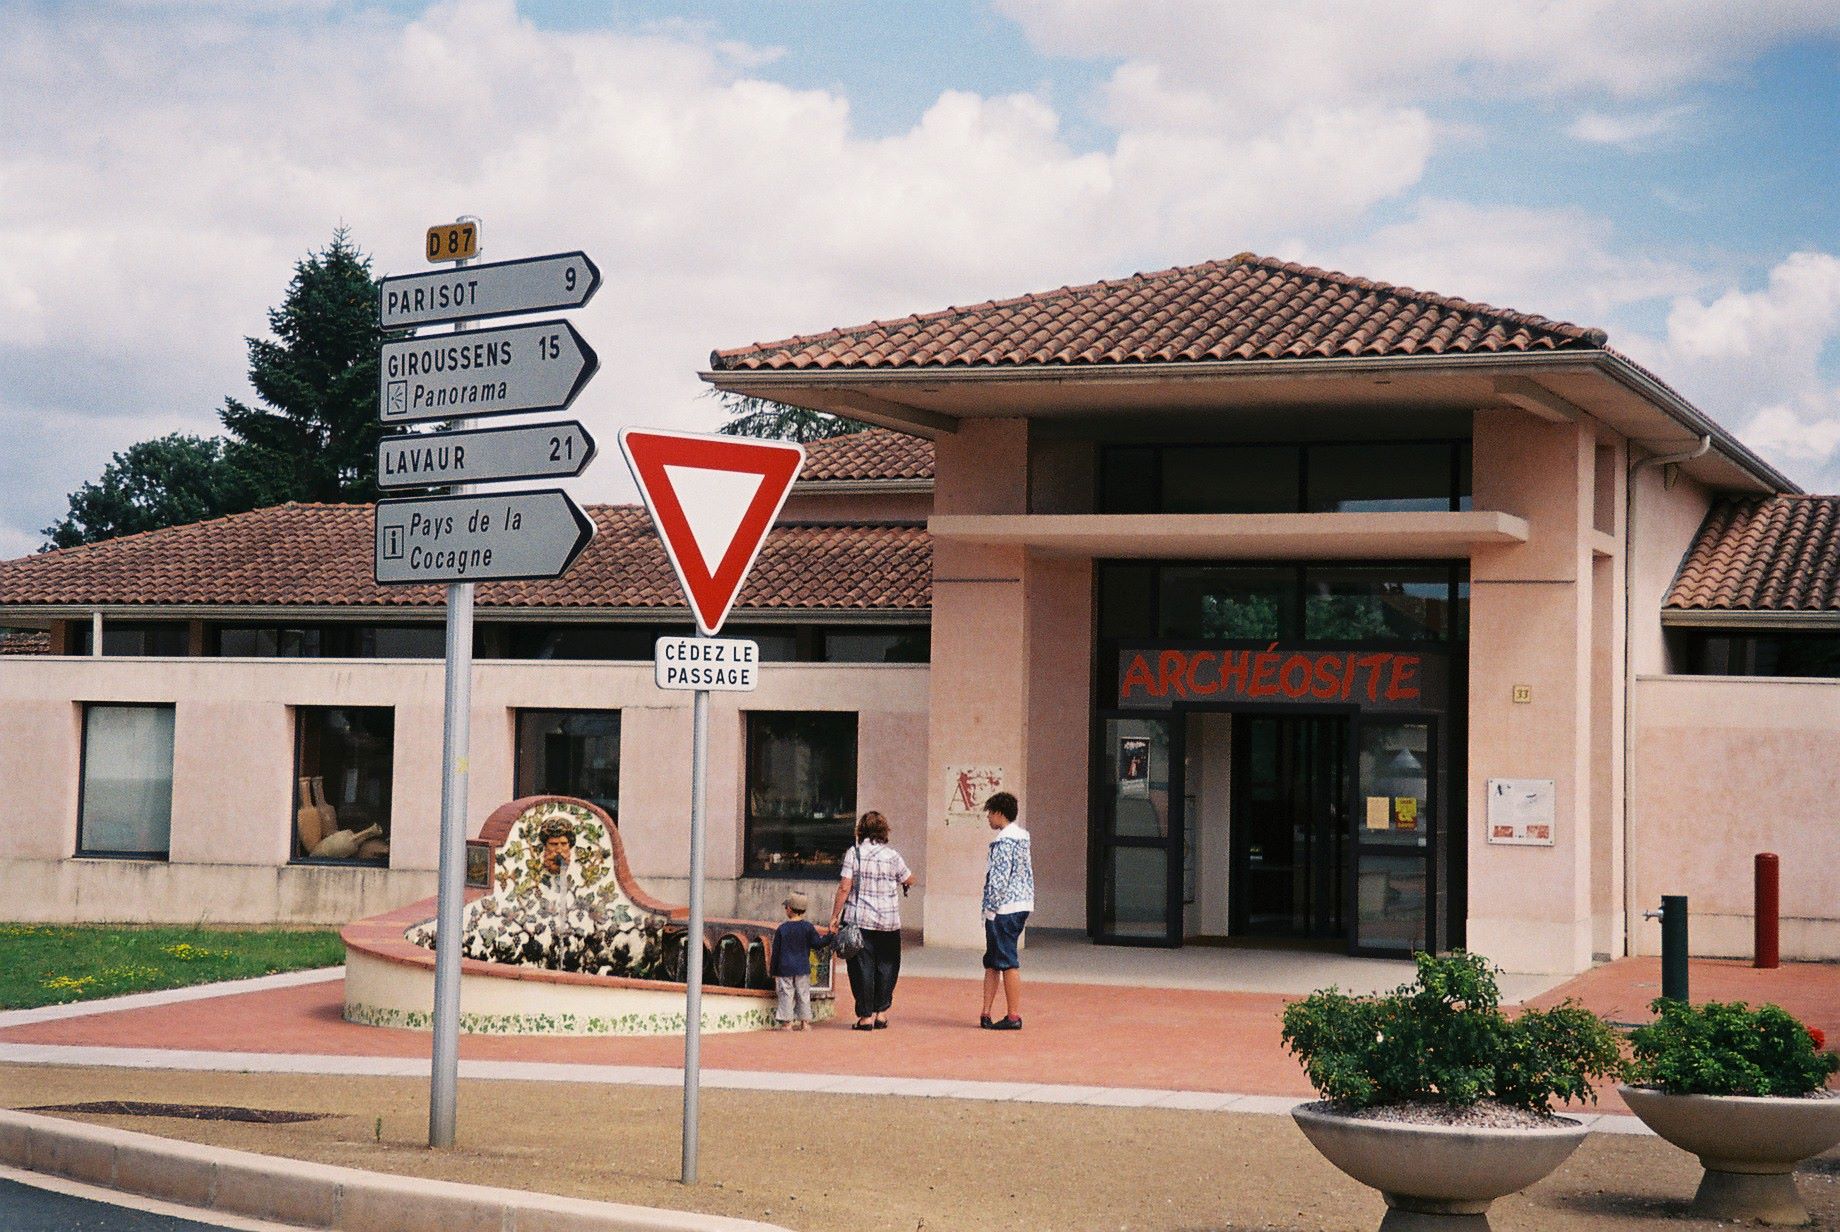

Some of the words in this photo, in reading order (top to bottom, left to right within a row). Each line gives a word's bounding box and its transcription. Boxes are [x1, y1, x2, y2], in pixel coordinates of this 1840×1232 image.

[429, 233, 441, 256] D
[449, 228, 473, 254] 87
[388, 280, 478, 315] PARISOT
[565, 266, 576, 291] 9
[388, 340, 512, 377] GIROUSSENS
[538, 334, 560, 360] 15
[413, 381, 507, 408] Panorama
[385, 446, 465, 475] LAVAUR
[549, 435, 573, 461] 21
[410, 512, 454, 541] Pays
[468, 509, 490, 532] de
[504, 507, 522, 530] la
[410, 546, 493, 574] Cocagne
[665, 641, 725, 662] CÉDEZ
[733, 646, 753, 663] LE
[667, 667, 750, 685] PASSAGE
[1121, 641, 1421, 704] ARCHÉOSITE
